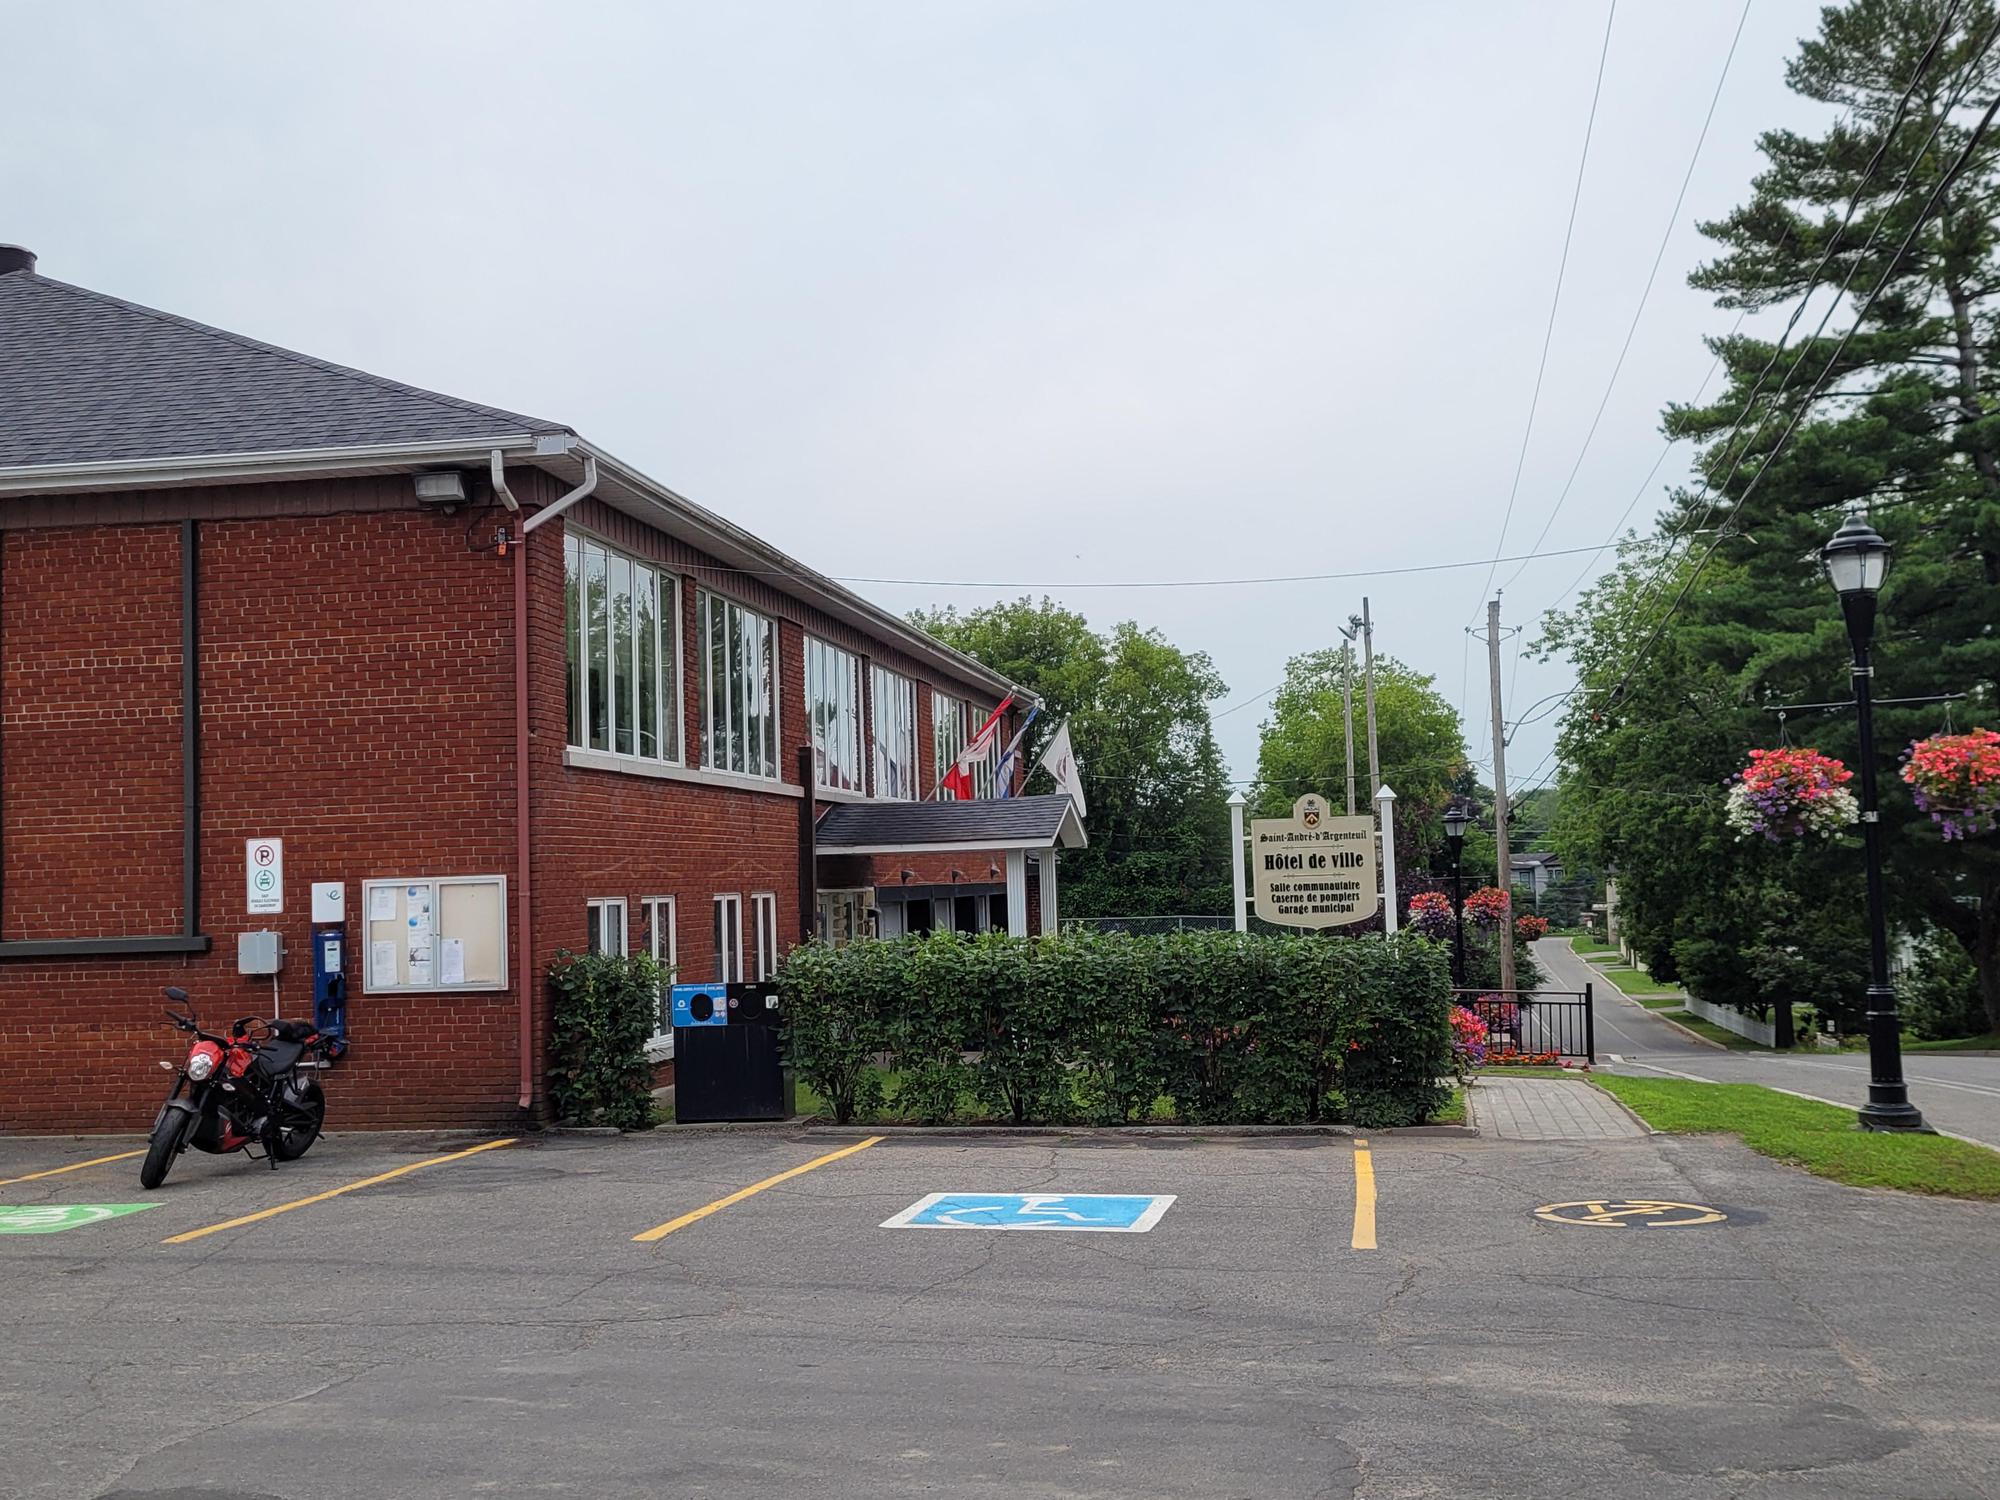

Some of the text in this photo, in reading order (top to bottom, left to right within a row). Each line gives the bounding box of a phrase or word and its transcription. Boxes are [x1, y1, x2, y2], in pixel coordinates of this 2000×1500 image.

[1264, 852, 1364, 870] Hôtel de ville
[1270, 880, 1361, 892] Salle communautaire
[1271, 892, 1360, 903] Caserne de pompiers
[1278, 903, 1354, 915] Garage municipal
